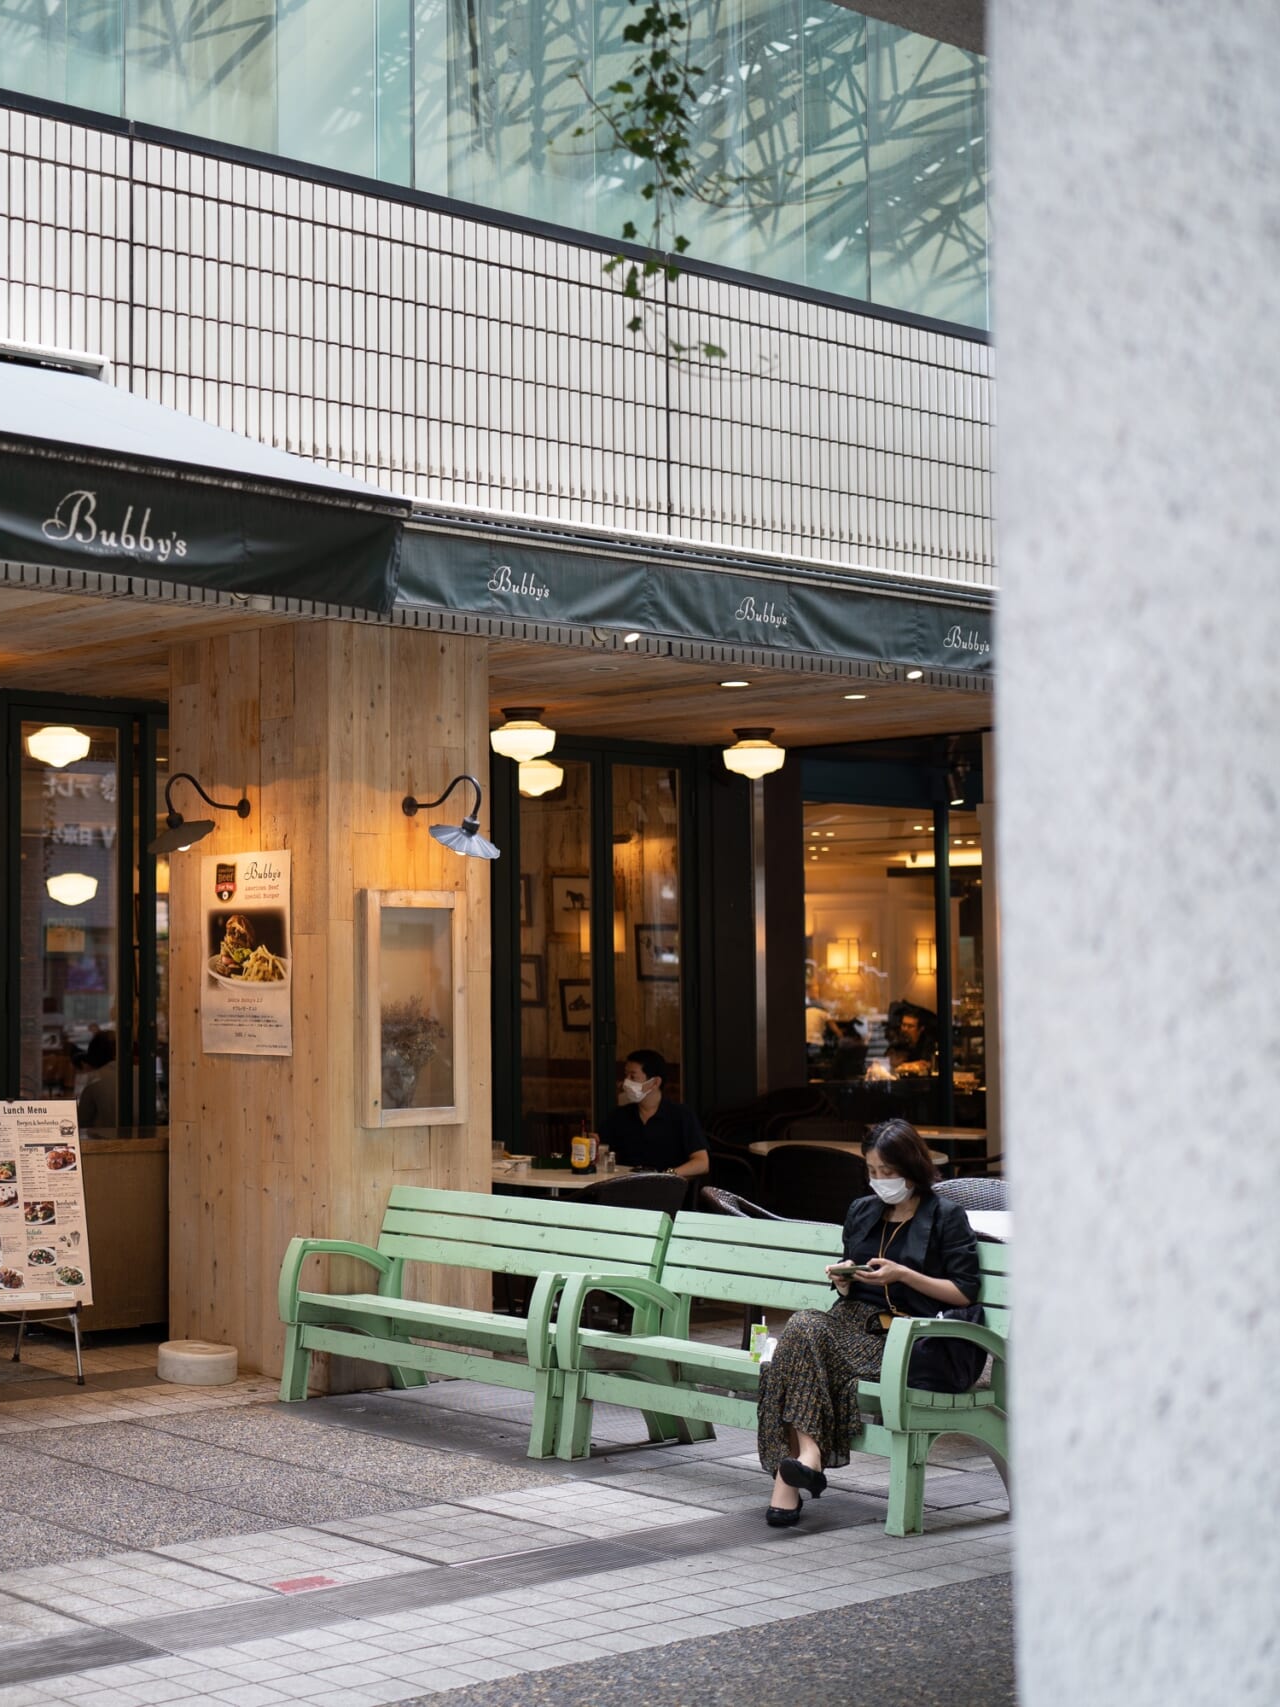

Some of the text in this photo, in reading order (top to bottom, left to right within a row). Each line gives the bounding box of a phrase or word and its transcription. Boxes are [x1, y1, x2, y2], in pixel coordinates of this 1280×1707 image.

[42, 490, 187, 561] Bubby's
[487, 565, 550, 601] Bubby's
[735, 596, 787, 628] Bubby's
[943, 625, 990, 655] Bubby's
[244, 861, 281, 881] Bubby's
[3, 1106, 25, 1114] Lunch
[27, 1106, 48, 1114] Menu
